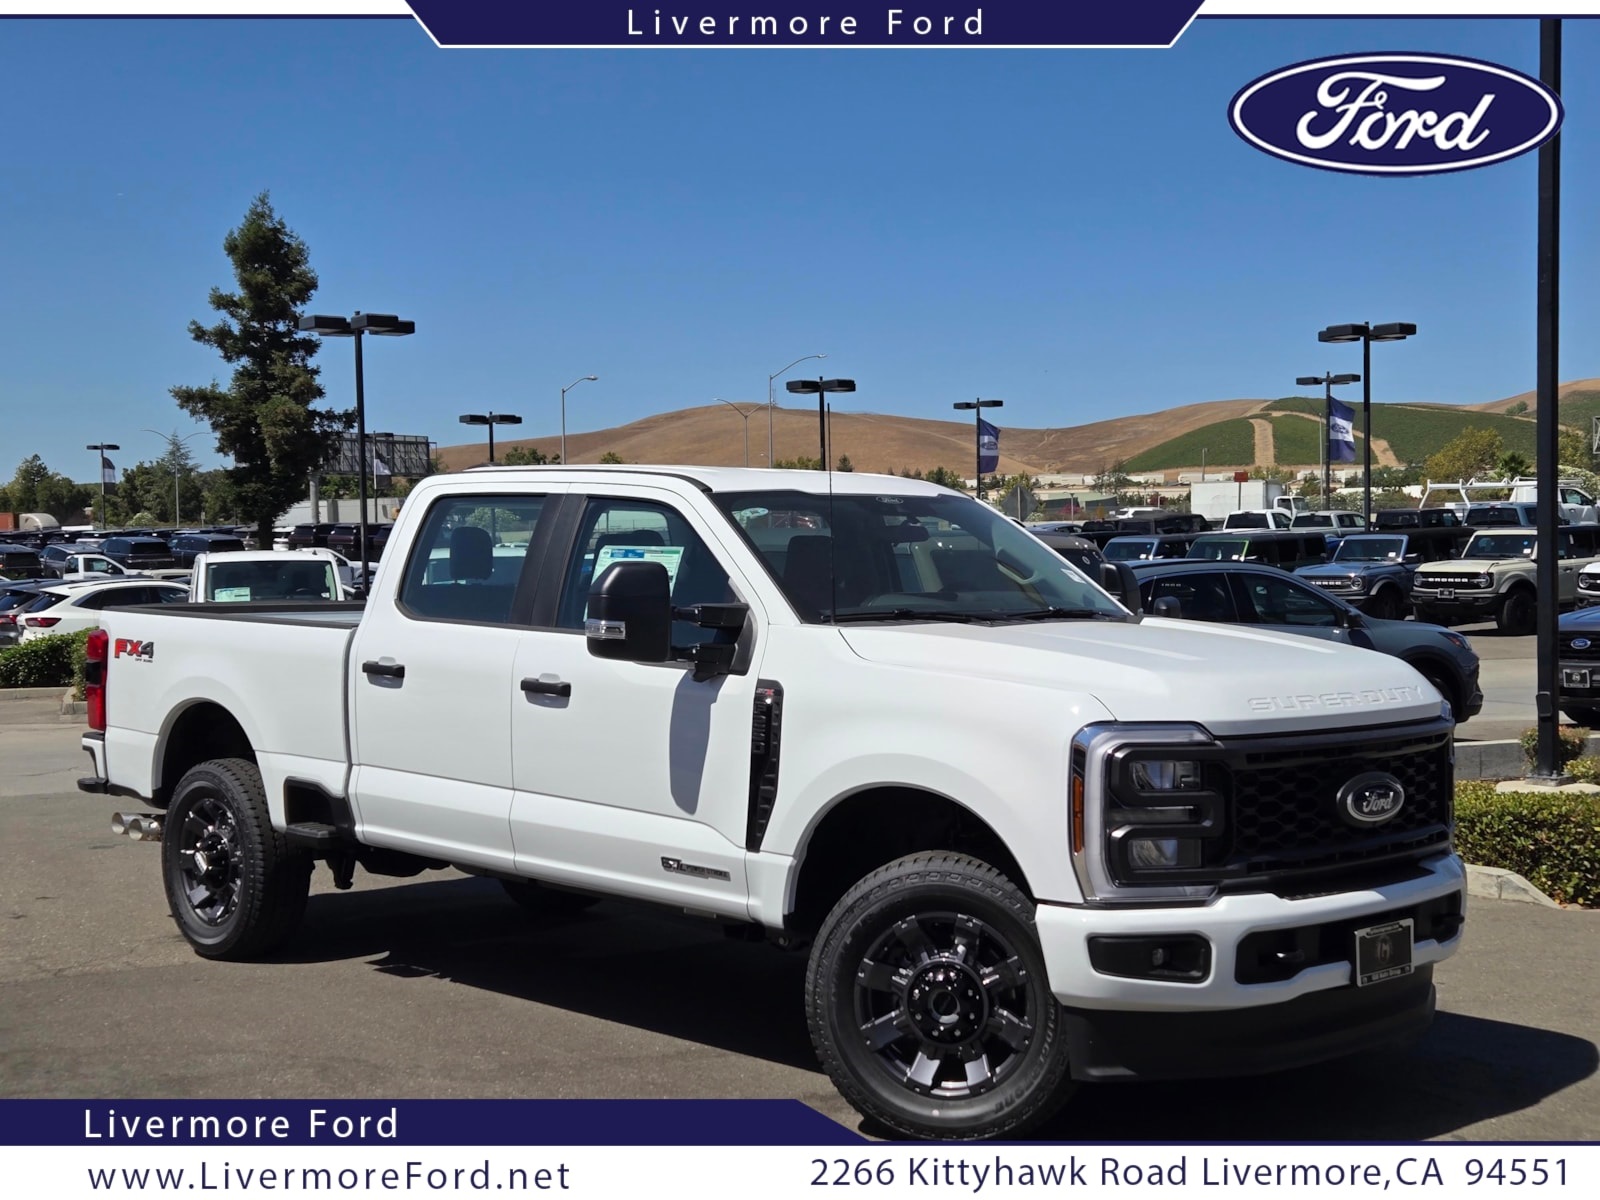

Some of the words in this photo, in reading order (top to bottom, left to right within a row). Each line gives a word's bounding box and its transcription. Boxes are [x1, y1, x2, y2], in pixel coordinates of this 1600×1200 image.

[114, 638, 154, 659] FX4
[1248, 692, 1361, 713] SUPER
[1360, 685, 1424, 705] DUTY
[1362, 788, 1394, 813] Ford
